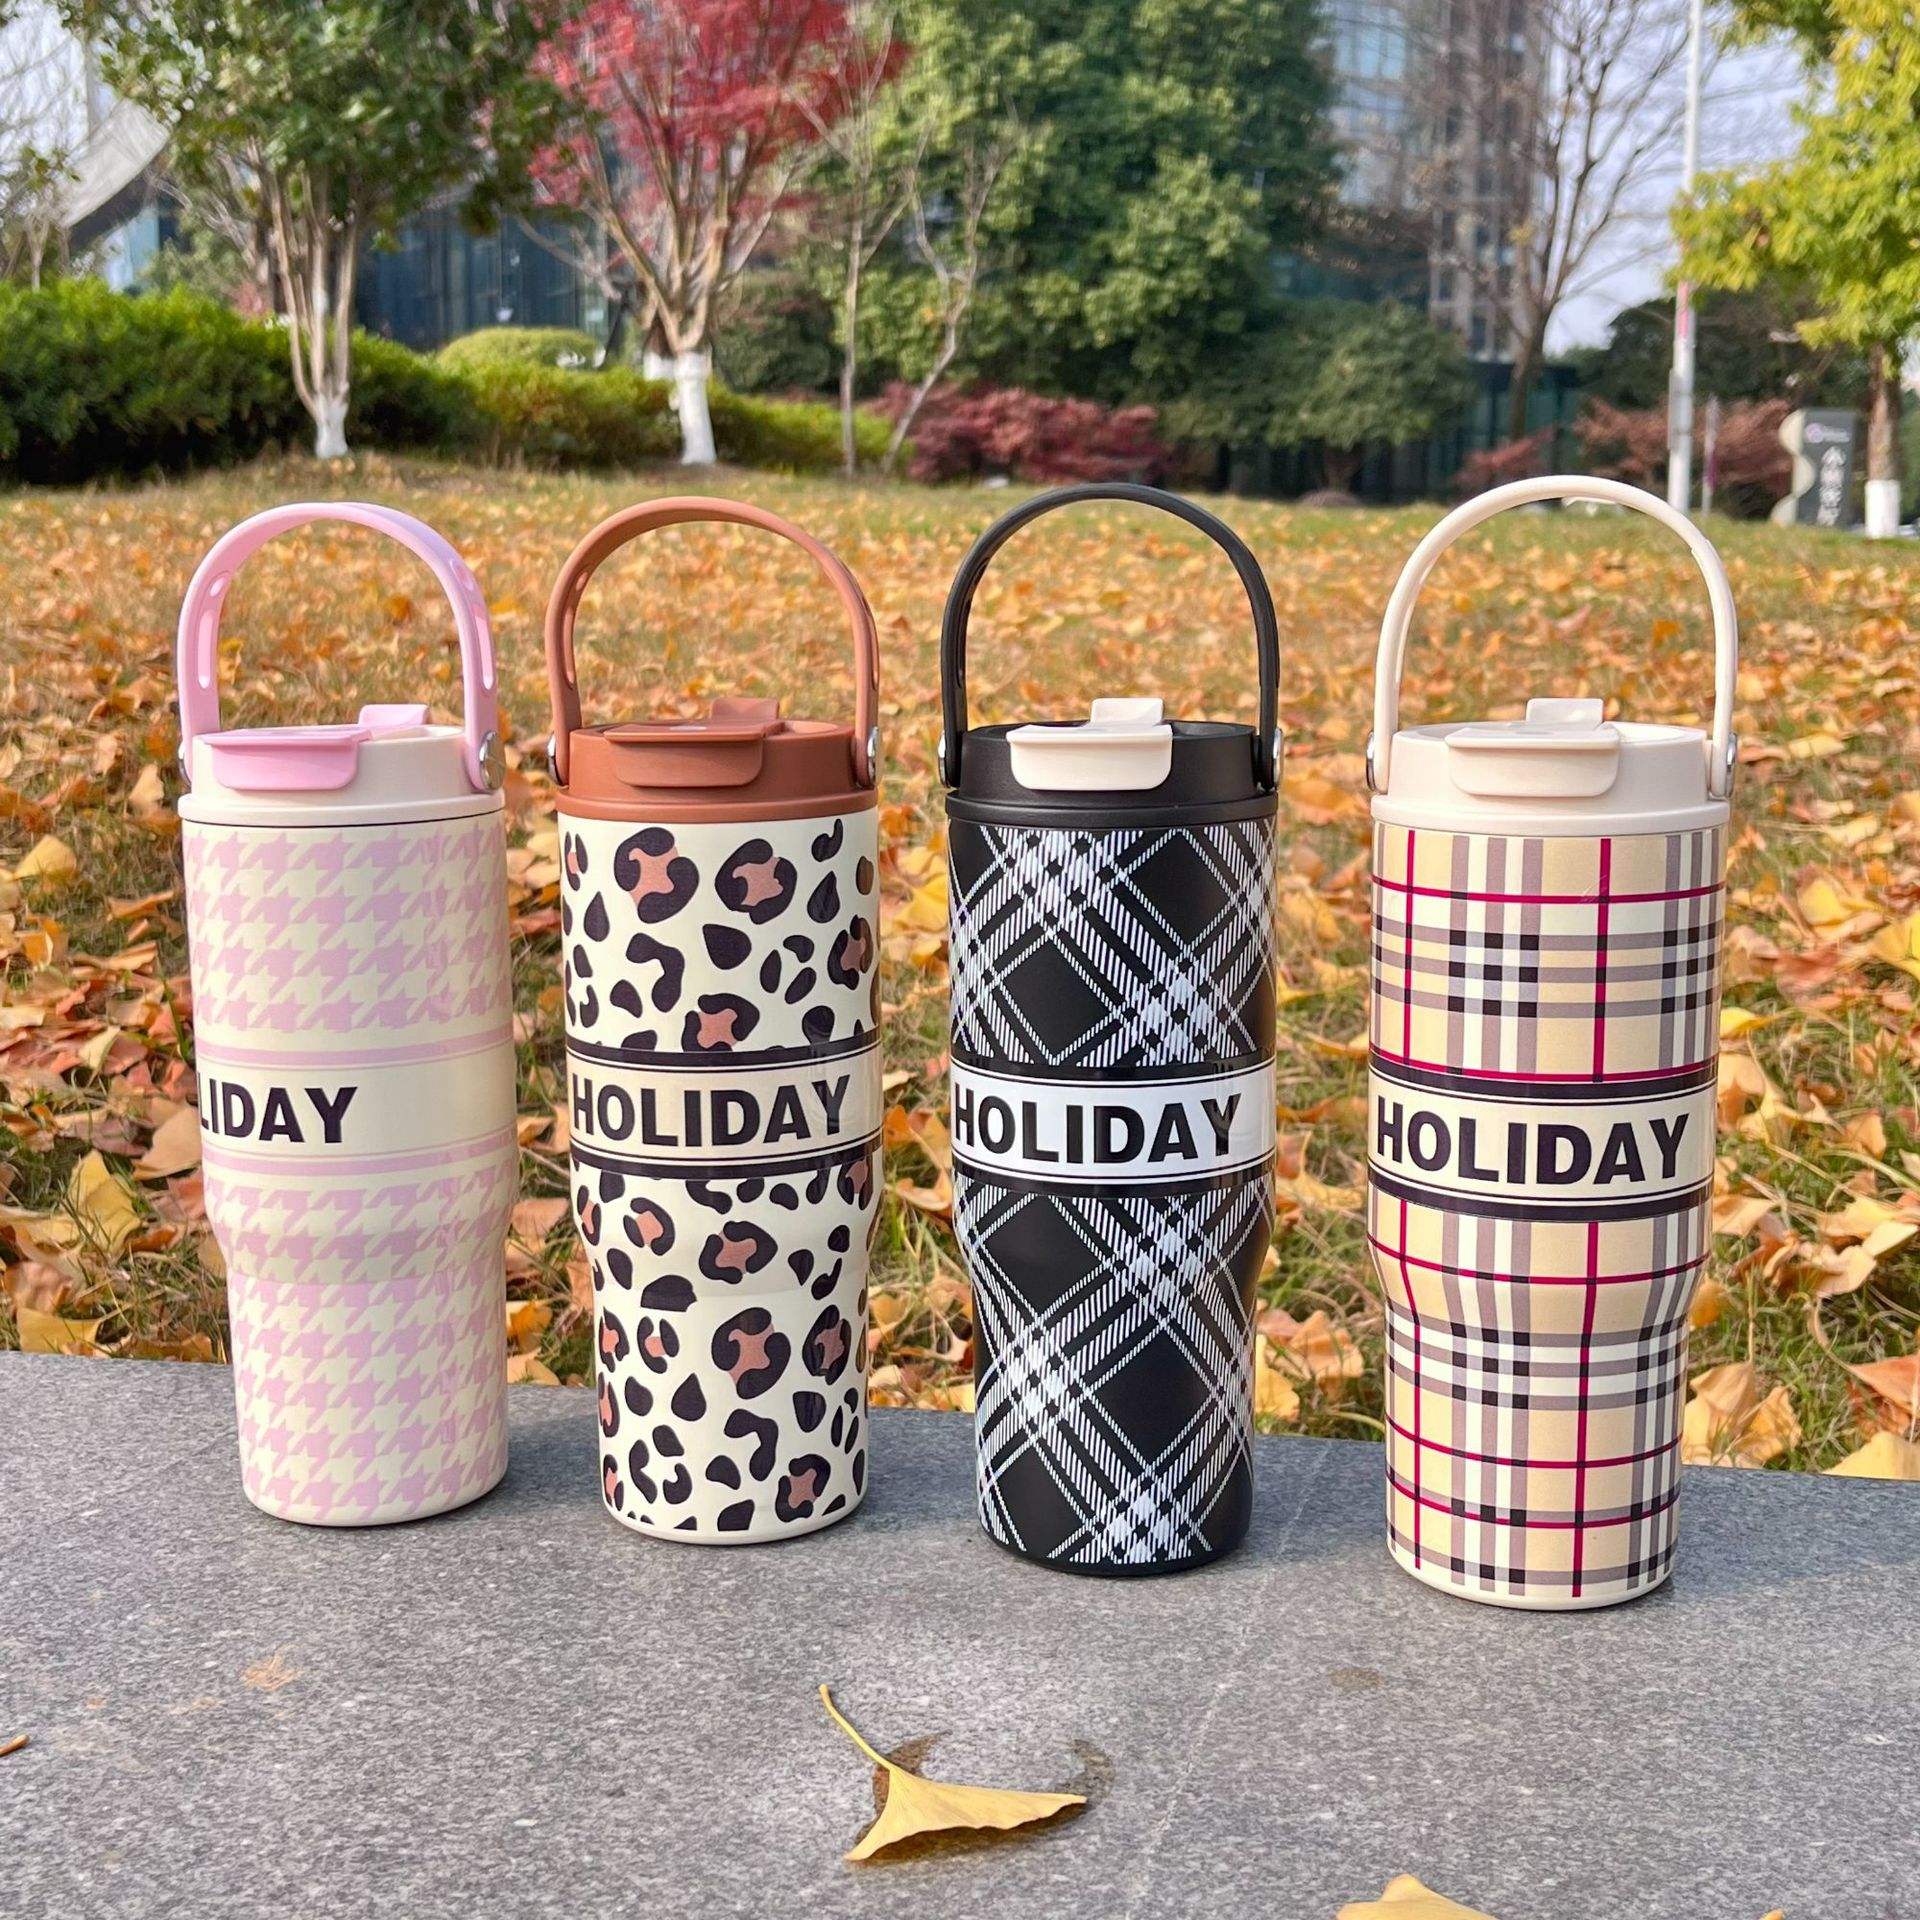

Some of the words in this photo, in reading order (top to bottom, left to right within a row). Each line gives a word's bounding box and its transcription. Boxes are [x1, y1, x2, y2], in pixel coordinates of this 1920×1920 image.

[572, 1072, 850, 1147] HOLIDAY
[954, 1082, 1242, 1164] HOLIDAY
[1377, 1095, 1690, 1185] HOLIDAY
